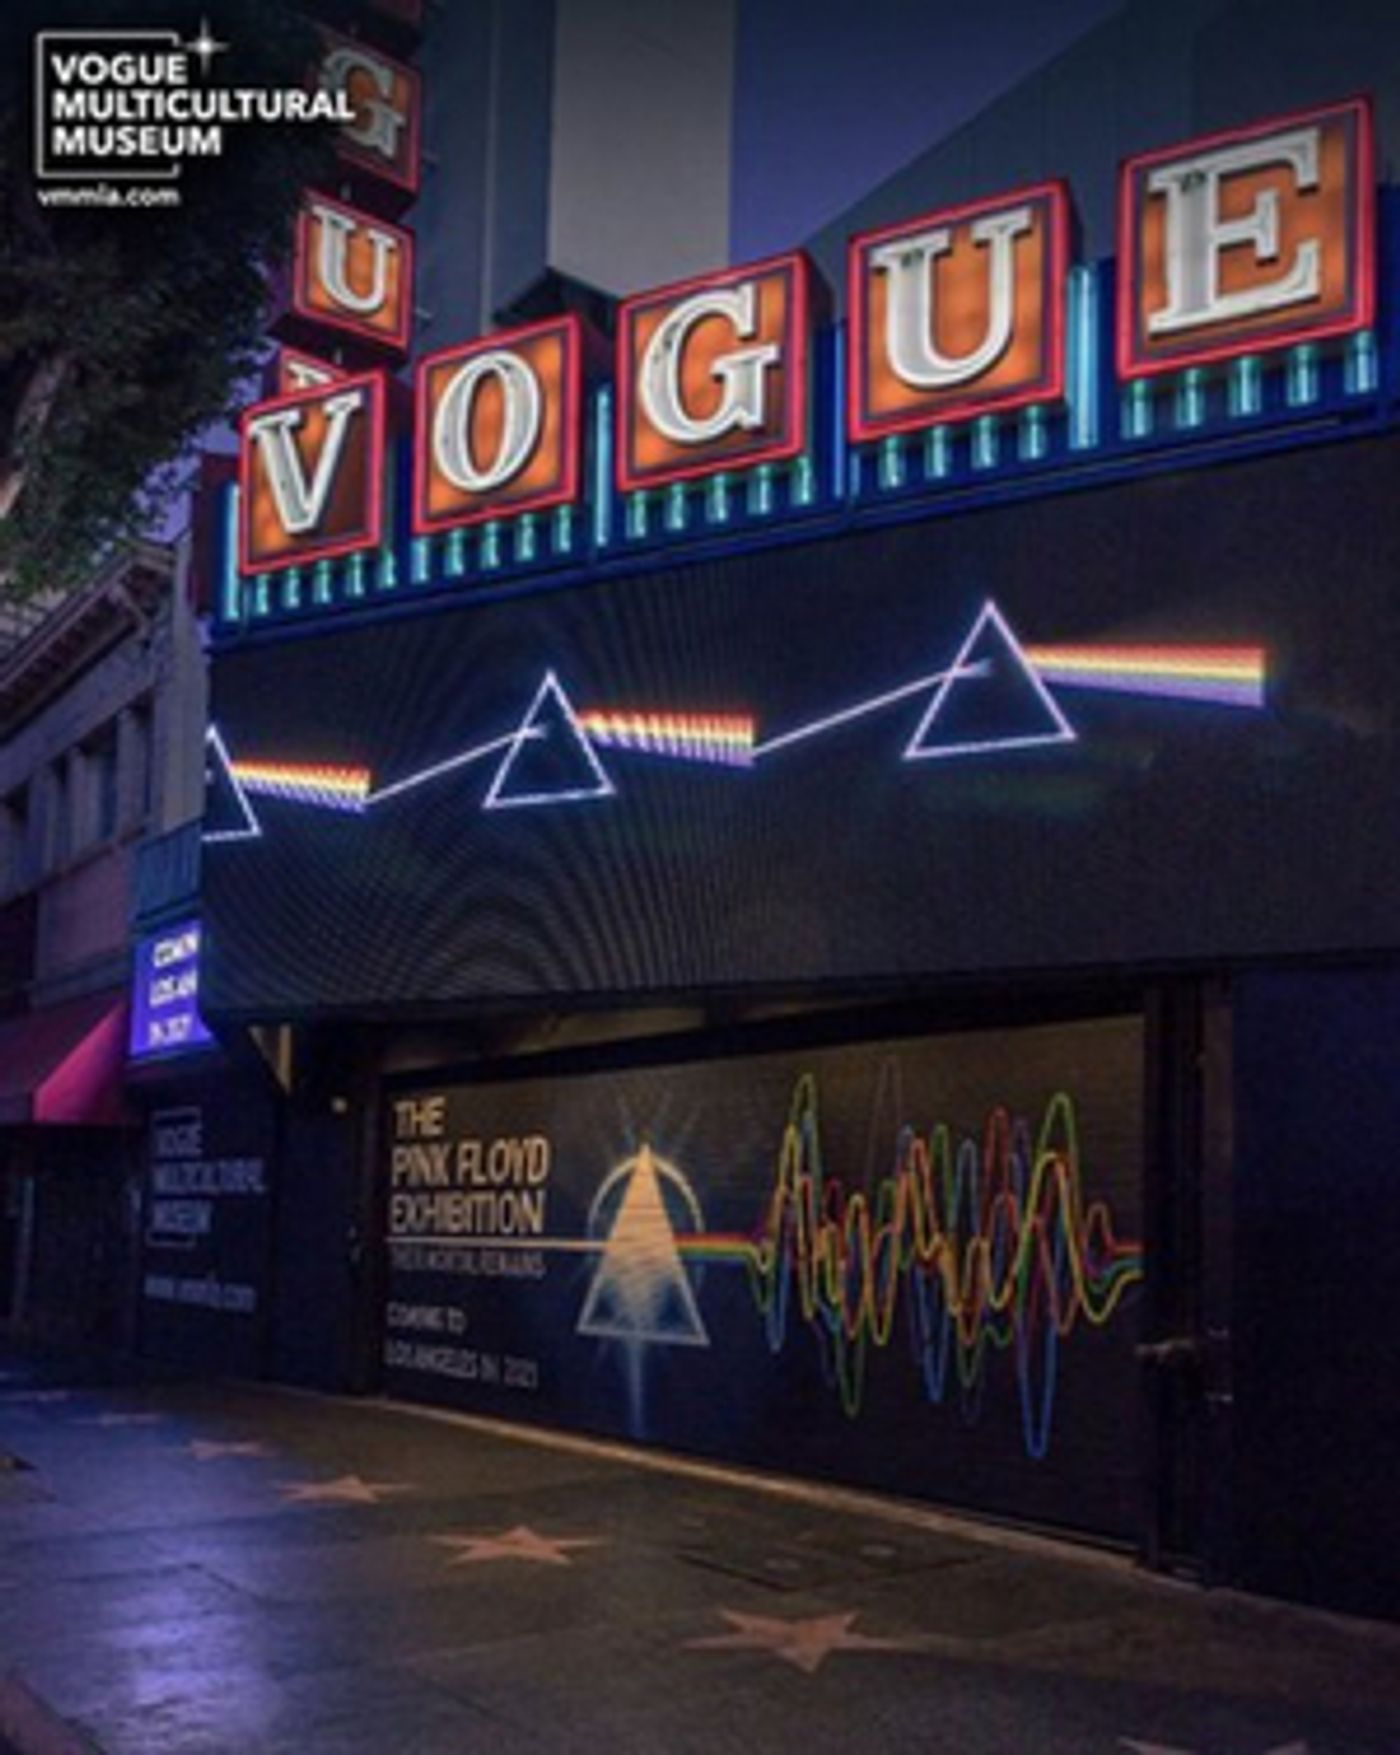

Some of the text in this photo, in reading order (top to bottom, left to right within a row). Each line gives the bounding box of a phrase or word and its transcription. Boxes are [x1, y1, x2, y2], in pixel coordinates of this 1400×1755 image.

[249, 126, 1321, 535] VOGUE
[393, 1096, 447, 1137] THE
[391, 1136, 550, 1187] PINK FLOYD
[390, 1190, 546, 1235] EXHIBITION
